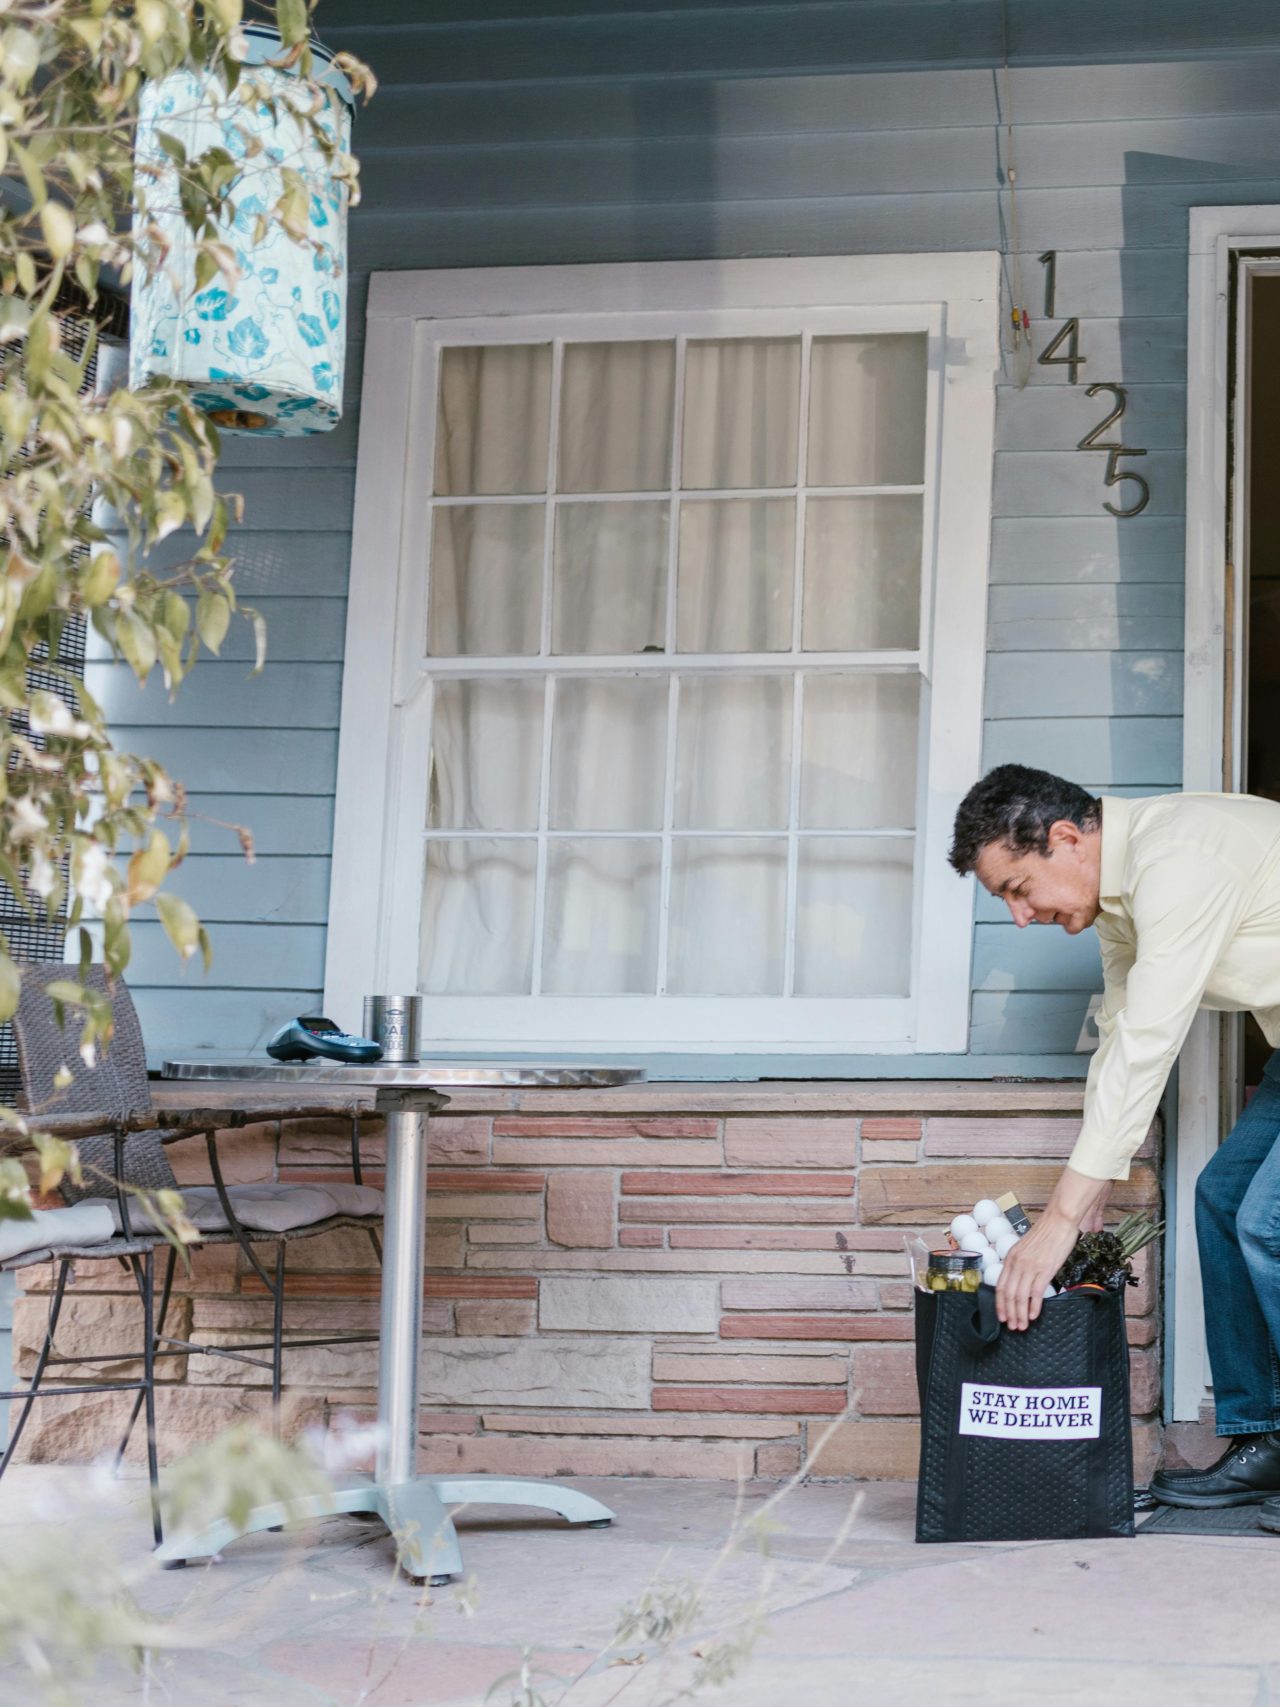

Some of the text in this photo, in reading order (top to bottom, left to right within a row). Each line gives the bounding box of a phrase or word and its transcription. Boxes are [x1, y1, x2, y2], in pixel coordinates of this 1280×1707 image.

[1038, 250, 1150, 517] 1425
[972, 1391, 1090, 1410] STAY HOME
[968, 1408, 1093, 1428] WE DELIVER
